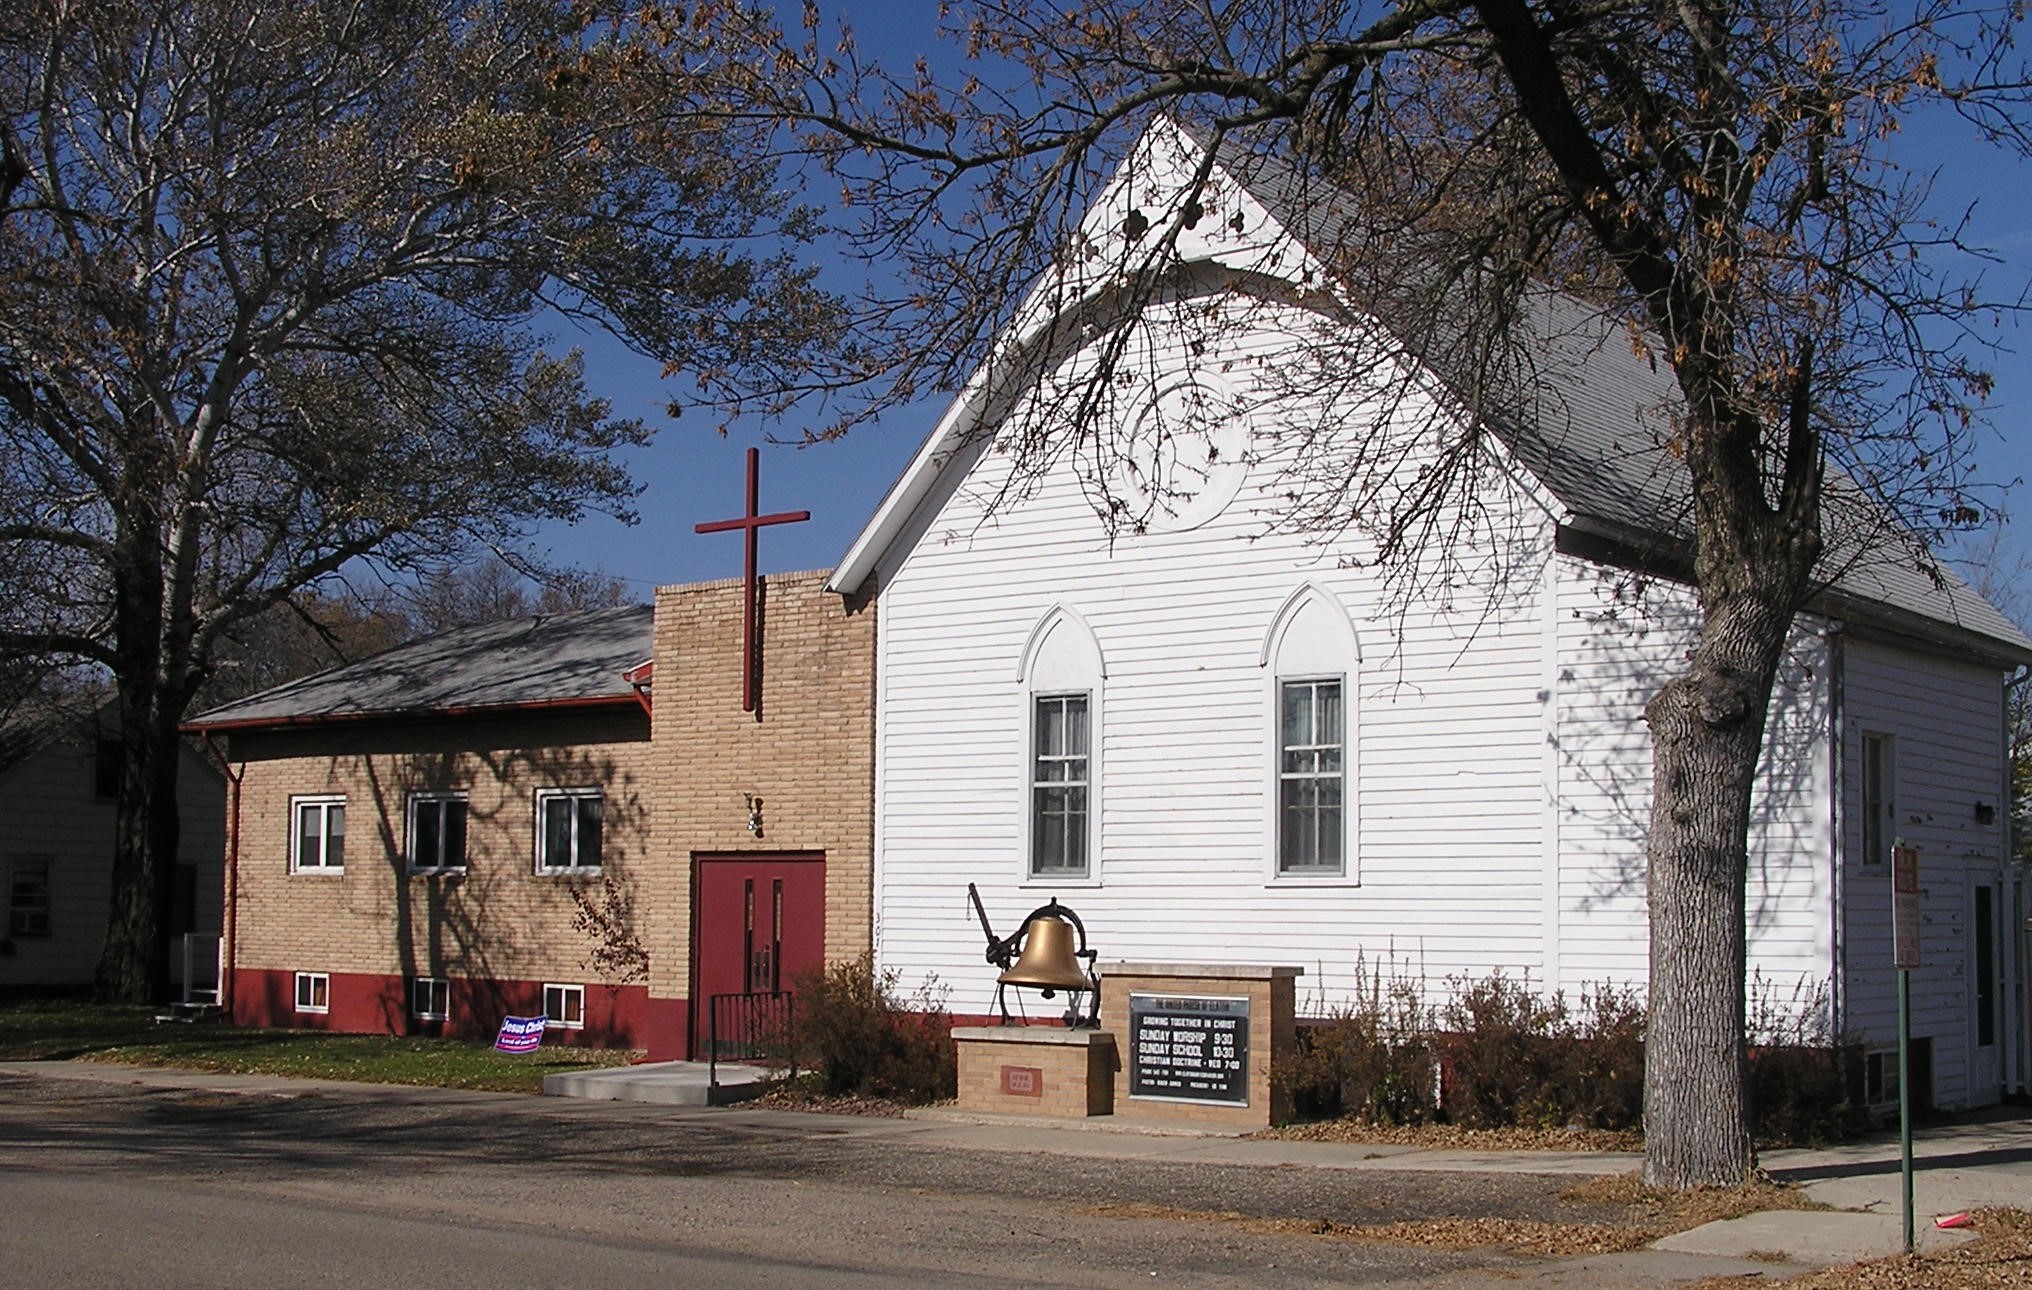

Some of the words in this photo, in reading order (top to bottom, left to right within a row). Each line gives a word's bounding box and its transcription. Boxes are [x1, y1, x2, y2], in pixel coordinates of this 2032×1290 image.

[502, 1020, 525, 1034] Jesus
[526, 1019, 546, 1034] Christ
[1143, 1016, 1169, 1026] GROWING
[1171, 1017, 1202, 1027] TOGETHER
[1204, 1019, 1211, 1028] IN
[1213, 1020, 1236, 1029] CHRIST
[1139, 1029, 1170, 1041] SUNDAY
[1173, 1031, 1206, 1044] WORSHIP
[1139, 1041, 1170, 1055] SUNDAY
[1173, 1043, 1203, 1057] SCHOOL
[1139, 1055, 1170, 1065] CHRISTIAN
[1172, 1057, 1202, 1067] DOCTRINE
[1208, 1059, 1221, 1068] WED
